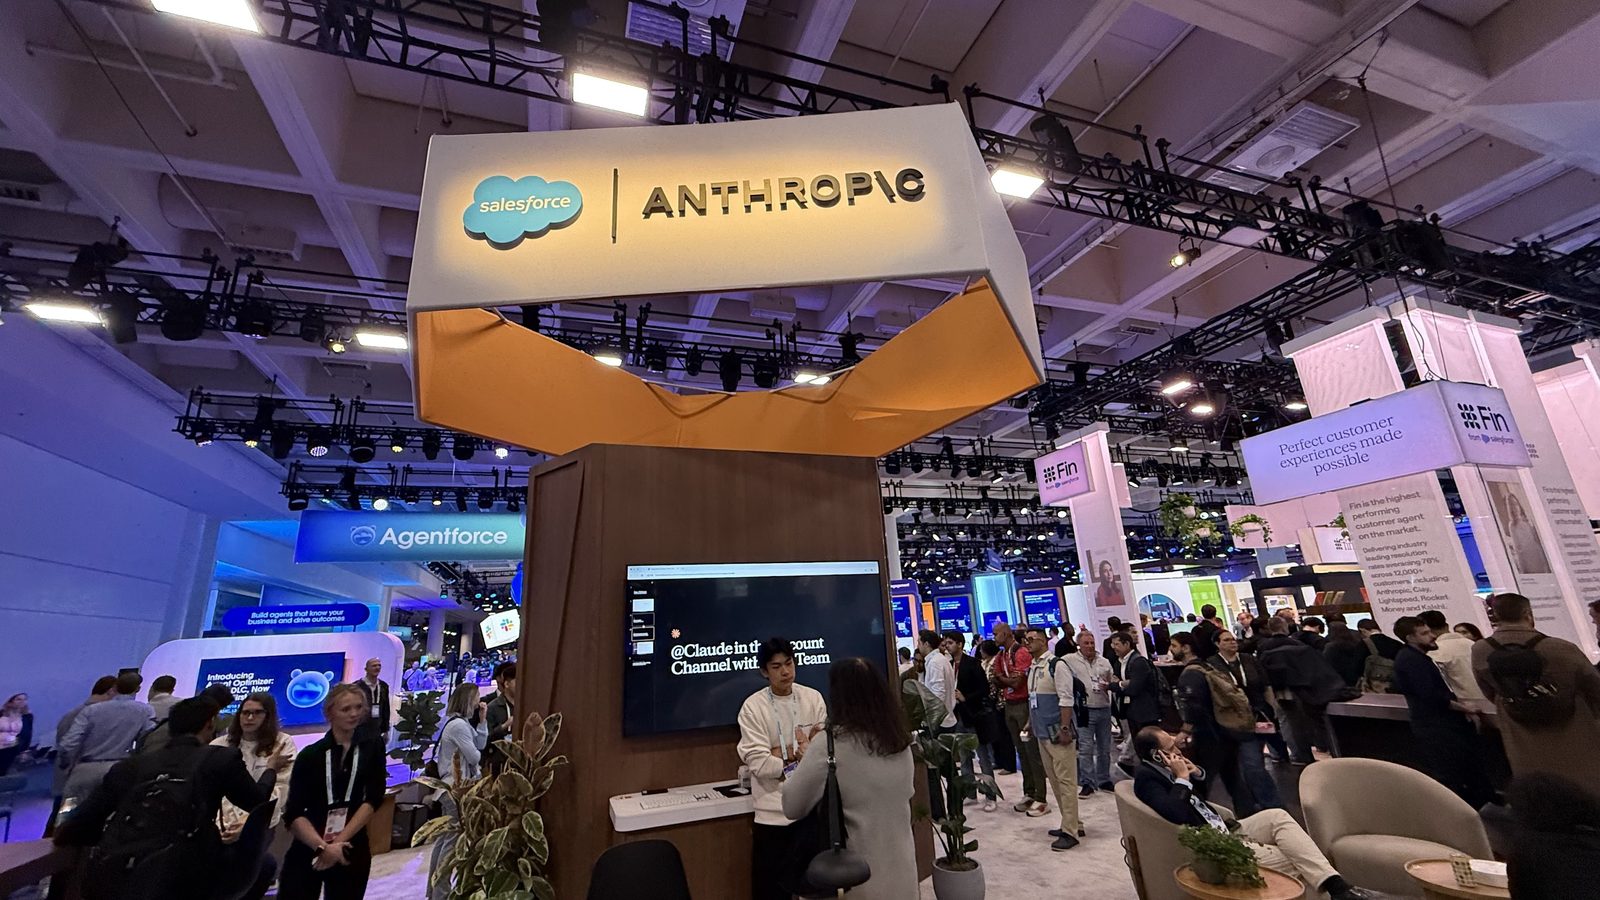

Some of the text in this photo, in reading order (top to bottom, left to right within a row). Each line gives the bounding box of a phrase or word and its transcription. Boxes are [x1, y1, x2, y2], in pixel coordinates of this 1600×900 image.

[479, 195, 571, 214] salesforce
[1476, 406, 1510, 432] Fin
[1279, 416, 1394, 455] Perfect customer
[1280, 429, 1403, 468] experiences made
[1057, 461, 1078, 479] Fin
[1314, 452, 1370, 476] possible
[1349, 502, 1362, 510] Fin
[1385, 491, 1421, 503] highest
[1352, 507, 1400, 521] performing
[1356, 513, 1424, 530] customer agent
[379, 527, 508, 550] Agentforce
[1386, 526, 1421, 536] market.
[1363, 544, 1396, 553] Delivering
[1366, 549, 1428, 562] leading resolution
[670, 638, 825, 660] @Claude in th count
[671, 658, 732, 675] Channel
[794, 652, 831, 666] Team
[207, 672, 254, 681] Introducing
[233, 678, 274, 687] Optimizer:
